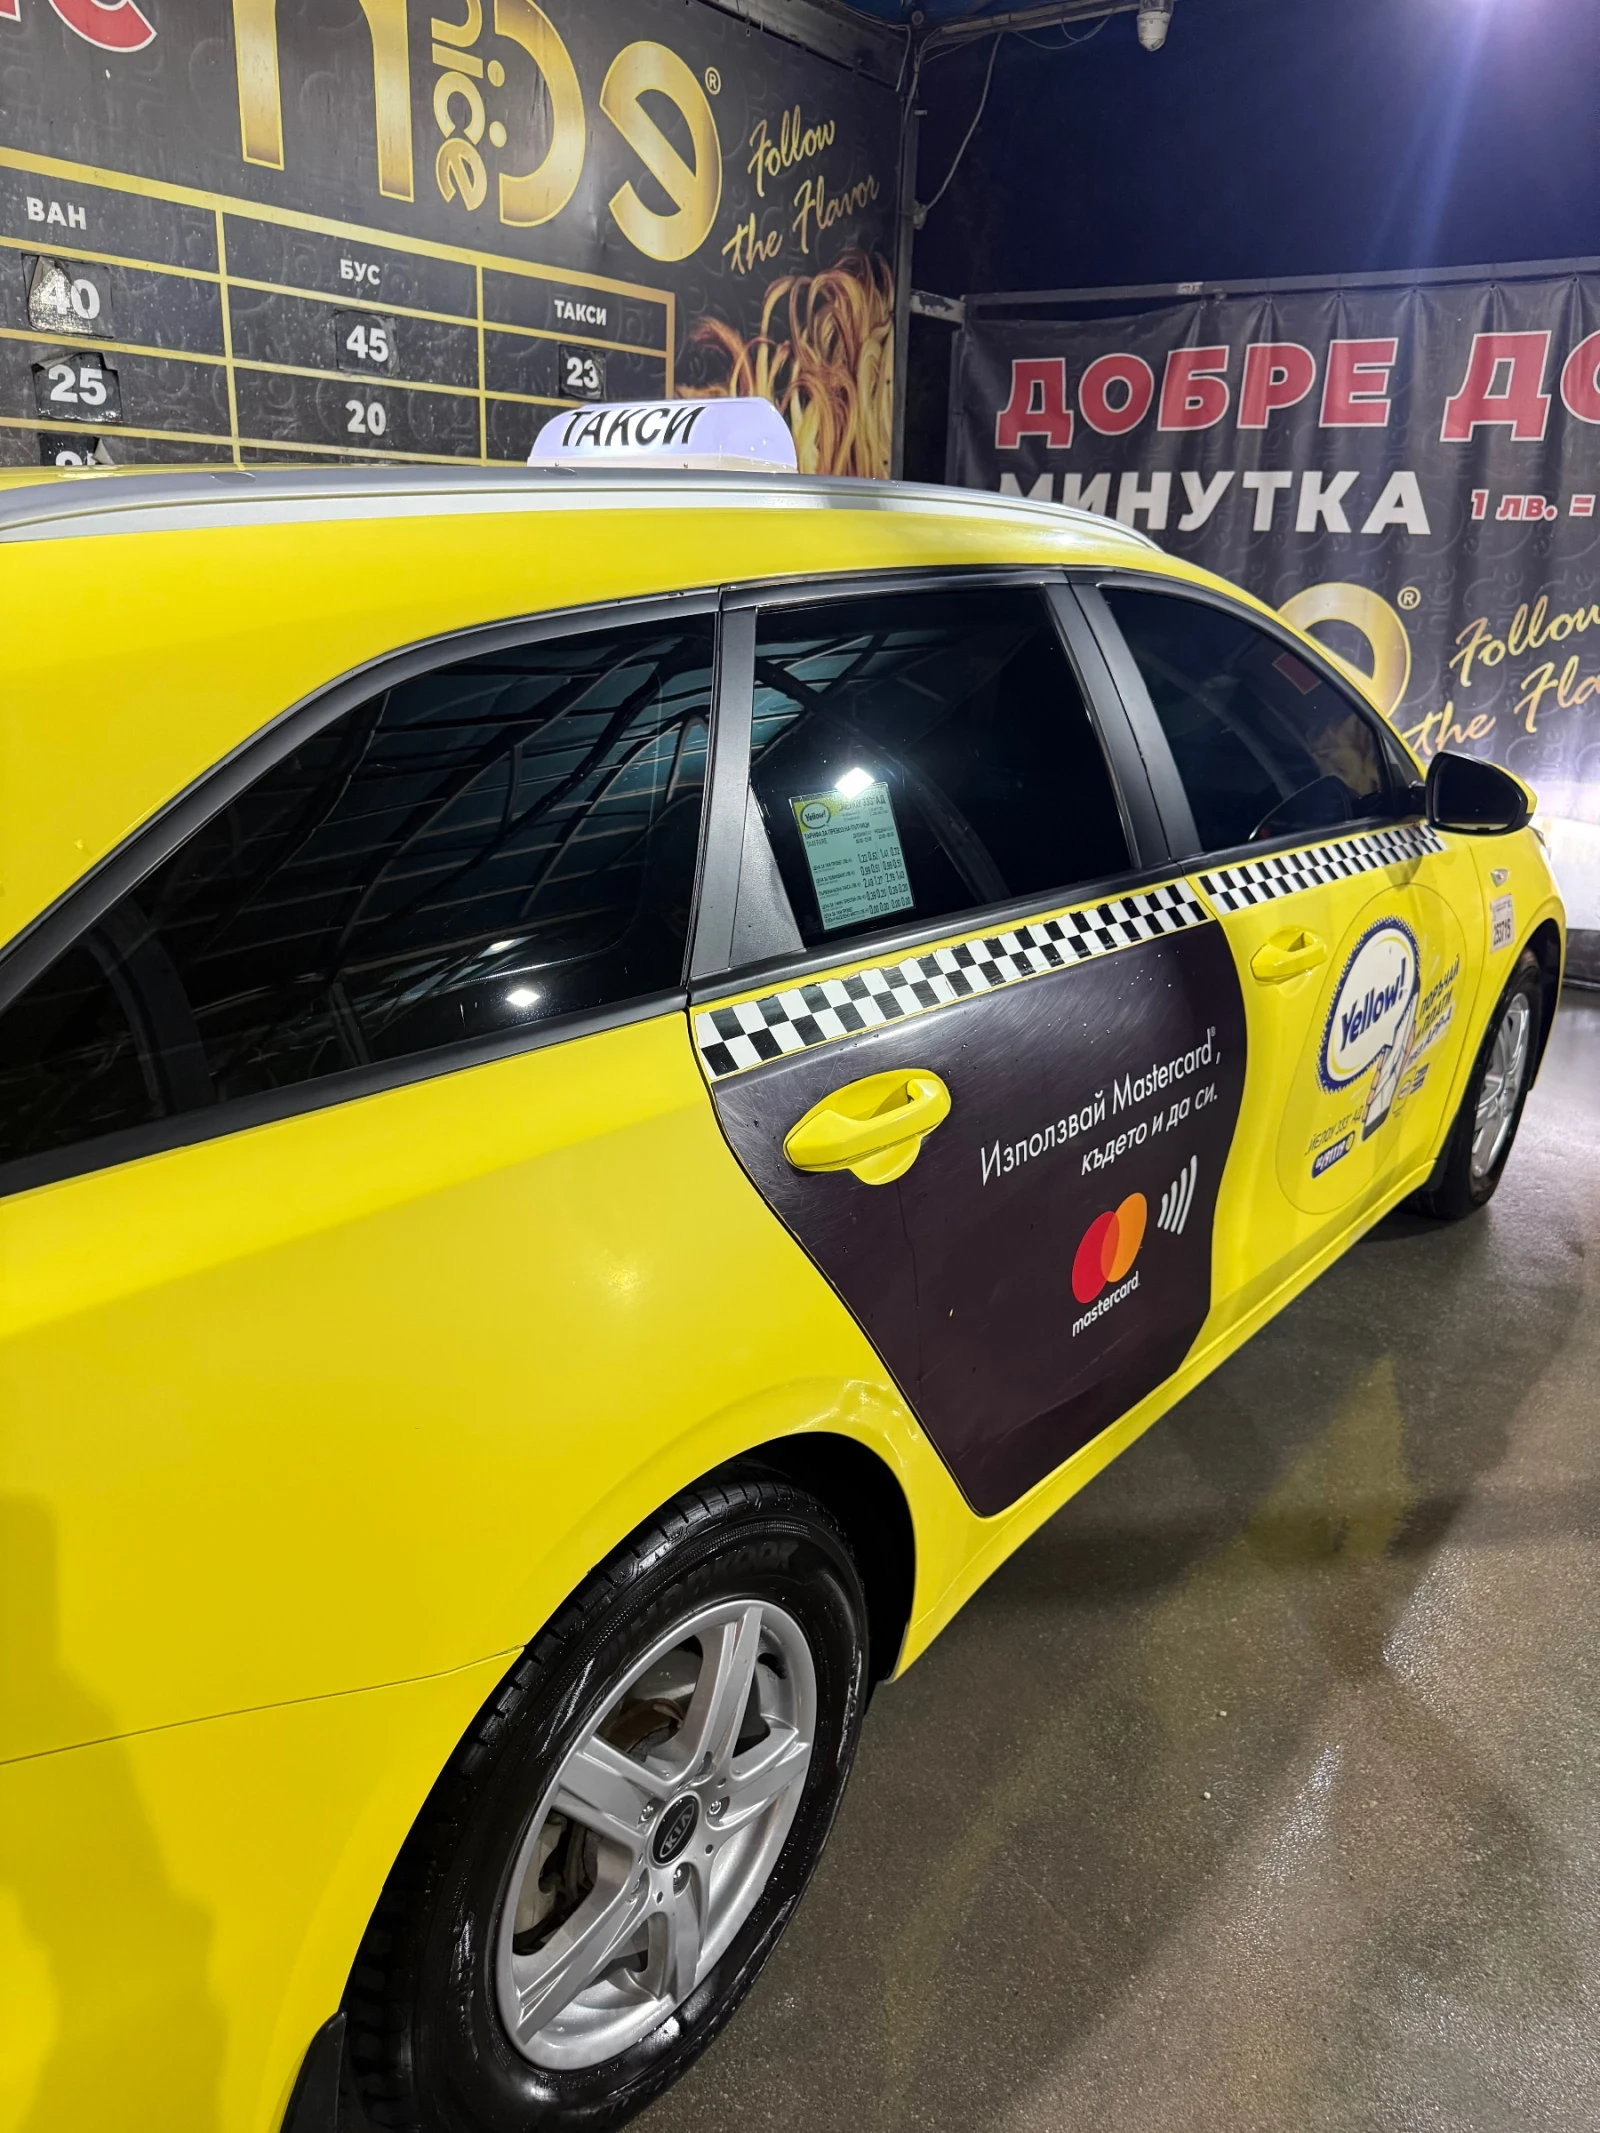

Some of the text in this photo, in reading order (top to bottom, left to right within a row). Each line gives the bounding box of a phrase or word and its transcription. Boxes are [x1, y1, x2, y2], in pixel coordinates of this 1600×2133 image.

[747, 105, 836, 196] Follow
[27, 197, 87, 230] ВАН
[721, 174, 880, 275] the Flavor
[340, 259, 380, 286] БУС
[41, 279, 100, 320] 40
[554, 300, 607, 326] ТАКСИ
[346, 325, 389, 363] 45
[48, 364, 107, 406] 25
[566, 357, 599, 389] 23
[995, 338, 1398, 450] ДОБРЕ
[346, 400, 387, 437] 20
[562, 405, 706, 448] ТАКСИ
[1471, 488, 1490, 520] 1
[1496, 494, 1558, 521] лв.
[1402, 700, 1497, 756] the
[804, 809, 827, 821] Yellow!
[1340, 957, 1407, 1053] Yellow!
[979, 1089, 1106, 1187] Използвай
[1081, 1082, 1218, 1176] където и да си.
[1072, 1270, 1141, 1338] mastercard
[663, 1810, 695, 1850] KIA
